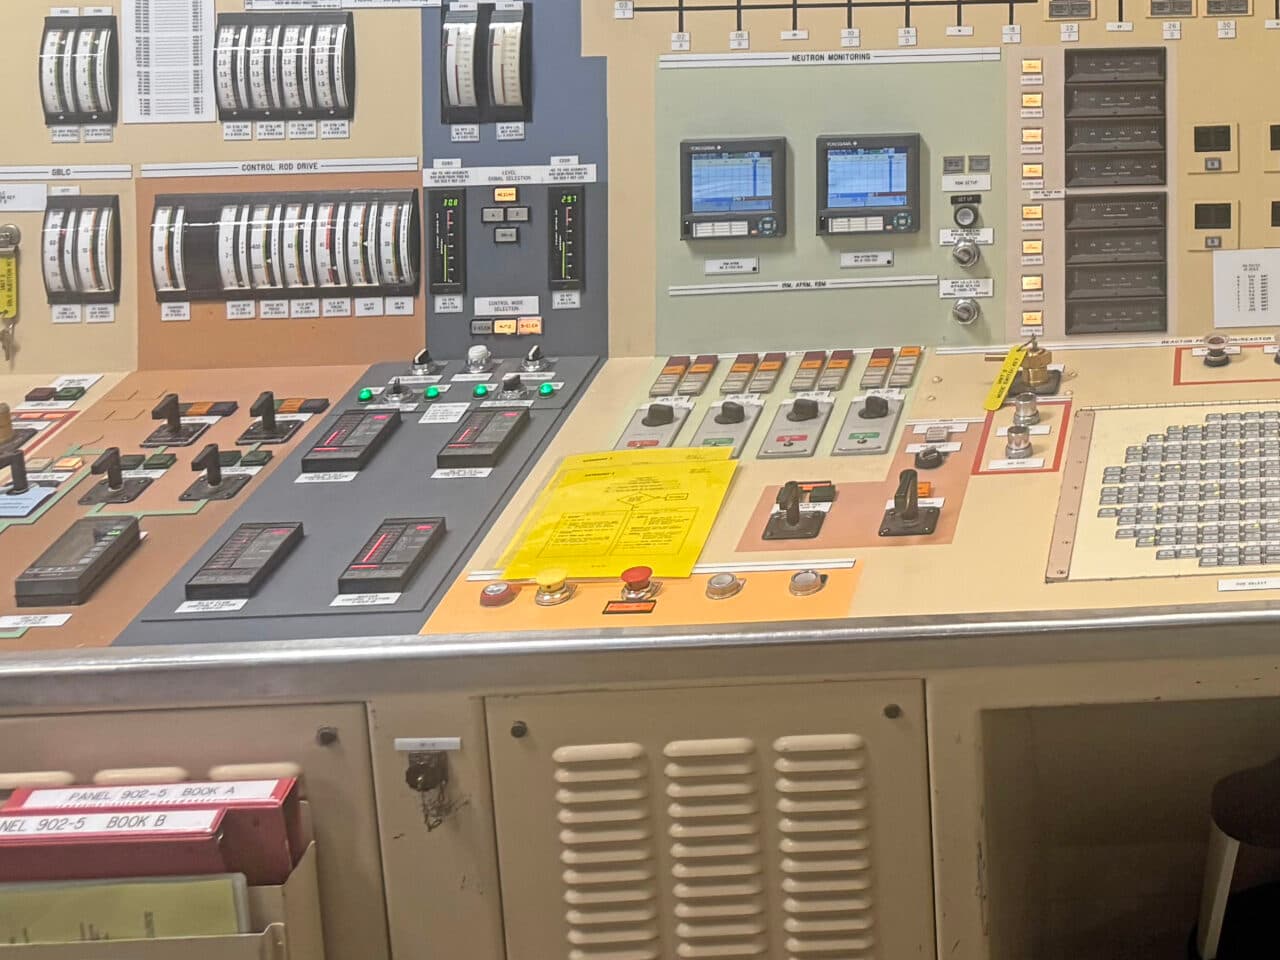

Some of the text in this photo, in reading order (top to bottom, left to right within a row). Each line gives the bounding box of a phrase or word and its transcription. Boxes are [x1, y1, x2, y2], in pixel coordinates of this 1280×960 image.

[791, 52, 871, 62] NEUTRON MONITORING
[241, 162, 319, 172] CONTROL ROD DRIVE
[51, 168, 71, 177] SBLC
[68, 785, 235, 802] PANEL 902-5 BOOK A
[32, 814, 88, 834] 902-5
[105, 815, 150, 829] BOOK
[153, 814, 168, 827] B
